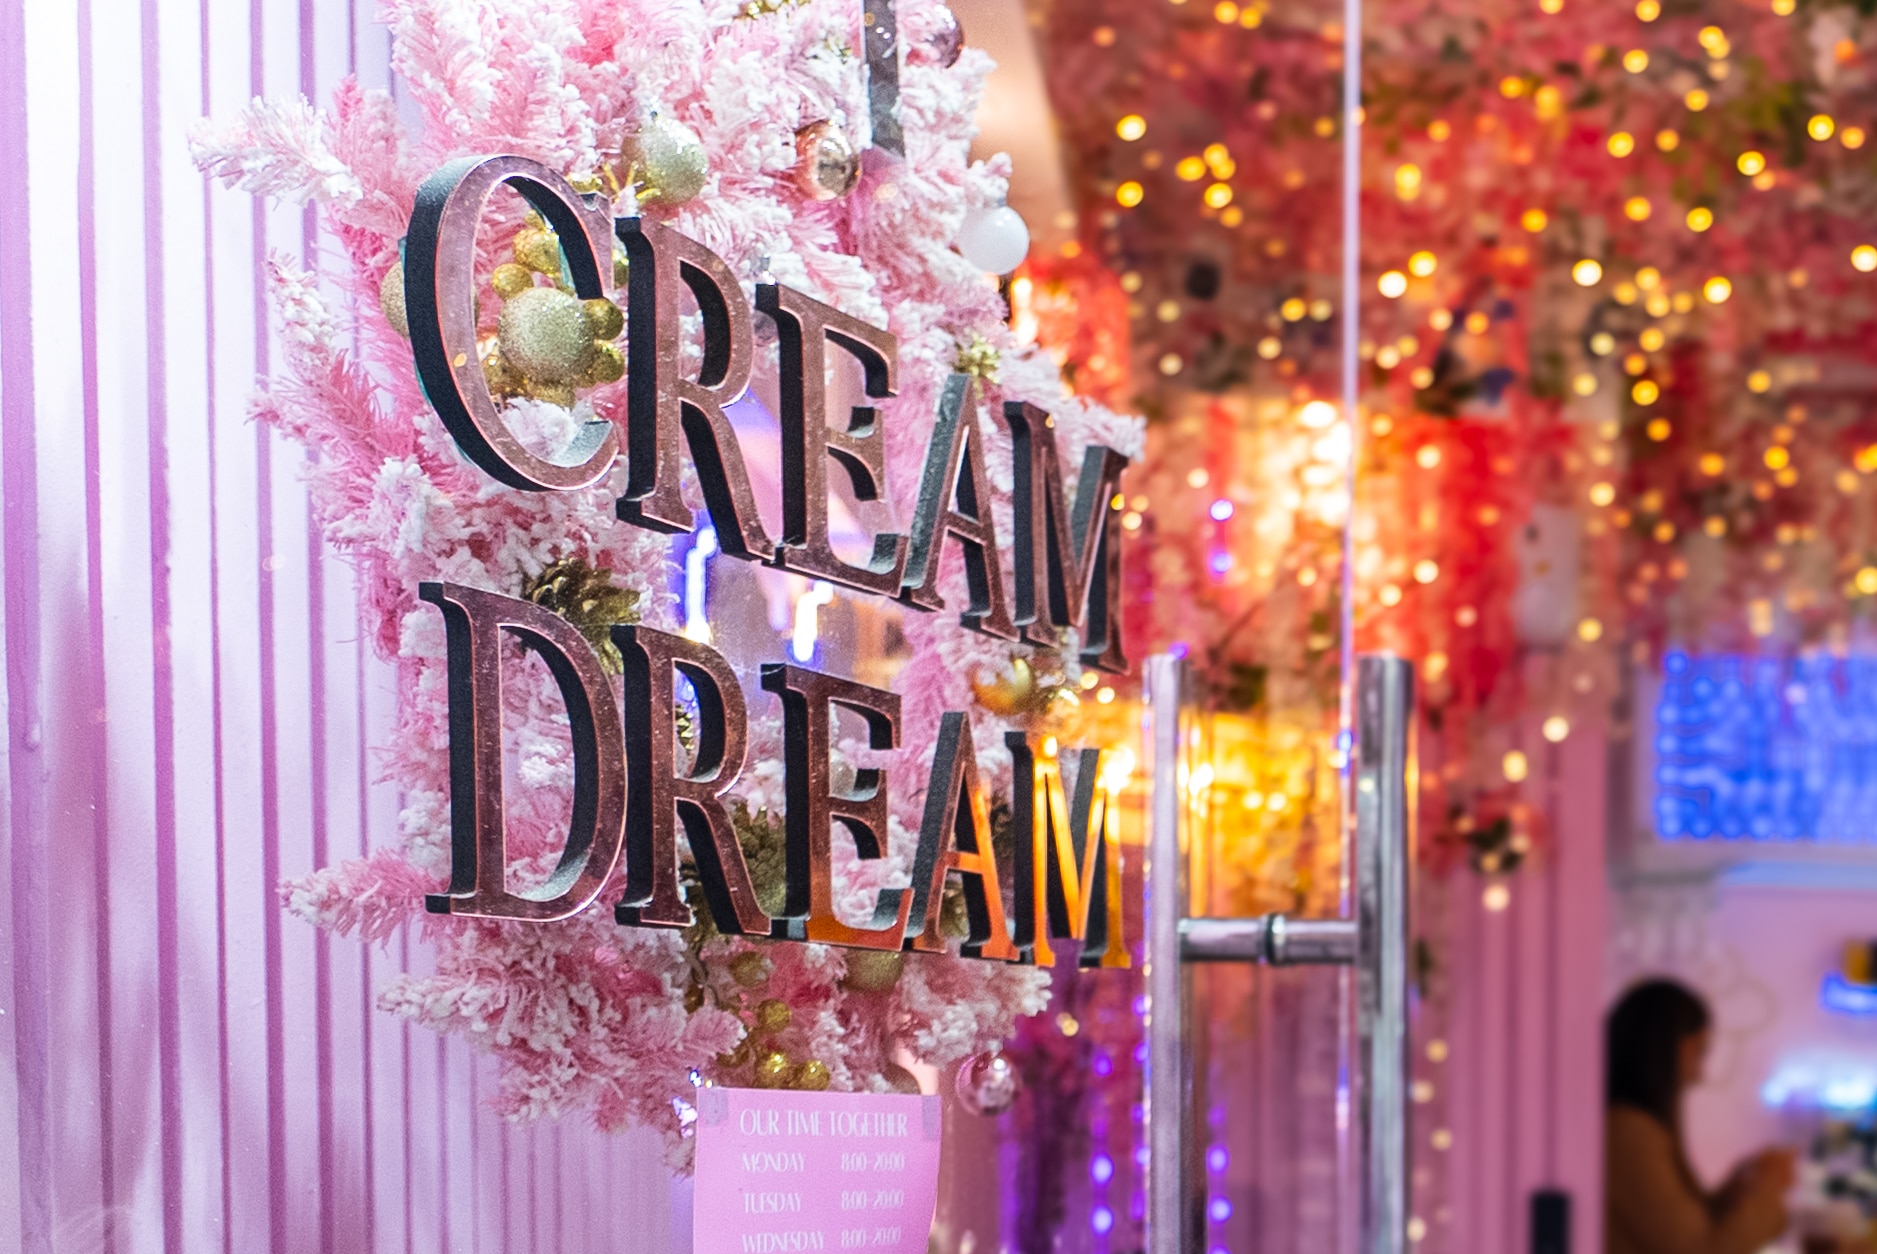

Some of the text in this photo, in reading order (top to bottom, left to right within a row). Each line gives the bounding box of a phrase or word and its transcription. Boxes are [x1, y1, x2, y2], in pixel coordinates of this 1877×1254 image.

[403, 153, 1130, 675] CREAM
[418, 581, 1131, 970] DREAM
[740, 1108, 908, 1138] OUR TIME TOGETHER
[742, 1152, 807, 1173] MONDAY
[744, 1192, 803, 1214] TUESDAY
[742, 1230, 825, 1254] WEDNESDAY
